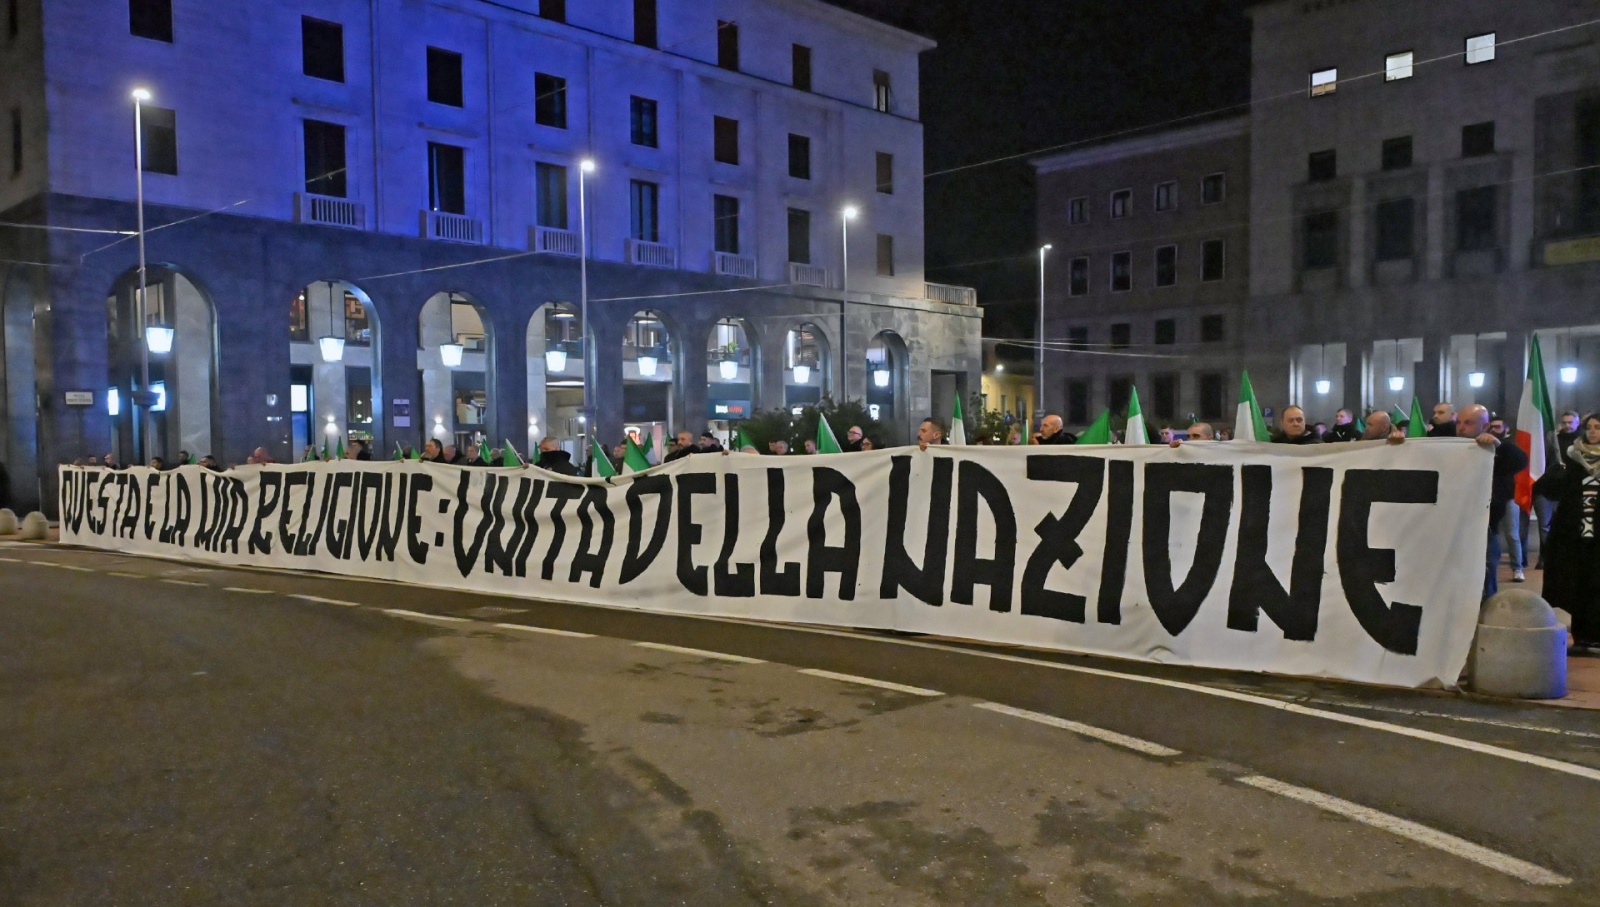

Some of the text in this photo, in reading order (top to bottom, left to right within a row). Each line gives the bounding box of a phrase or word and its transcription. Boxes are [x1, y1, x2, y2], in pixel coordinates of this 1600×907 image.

[62, 471, 141, 539] QUESTA
[159, 473, 191, 547] LA
[194, 472, 249, 554] MIA
[619, 467, 861, 600] DELLA
[880, 455, 1439, 656] NAZIONE
